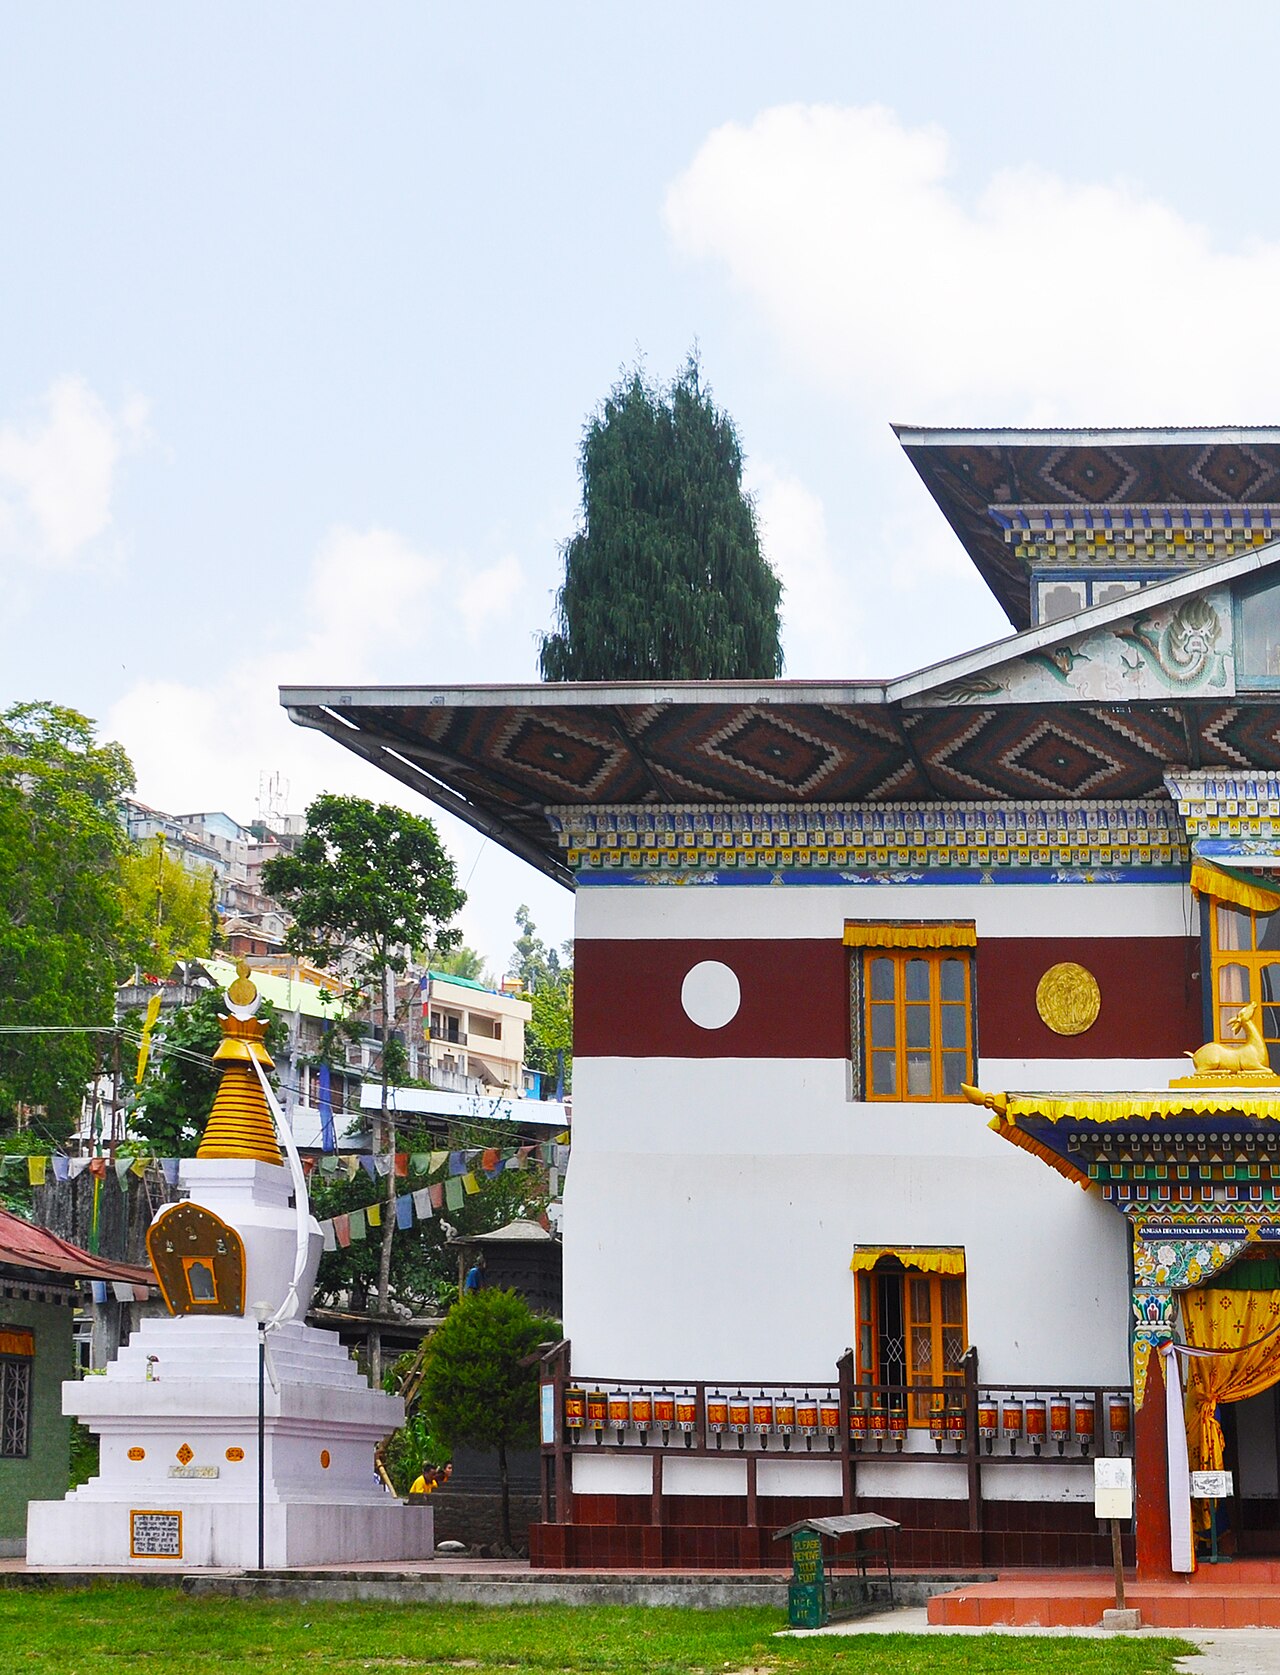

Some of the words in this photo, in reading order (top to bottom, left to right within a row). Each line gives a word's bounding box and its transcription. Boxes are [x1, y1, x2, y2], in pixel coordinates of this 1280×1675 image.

[794, 1540, 819, 1550] PLEASE
[793, 1551, 819, 1561] REMOVE
[798, 1561, 816, 1572] YOUR
[798, 1573, 816, 1583] FOOT
